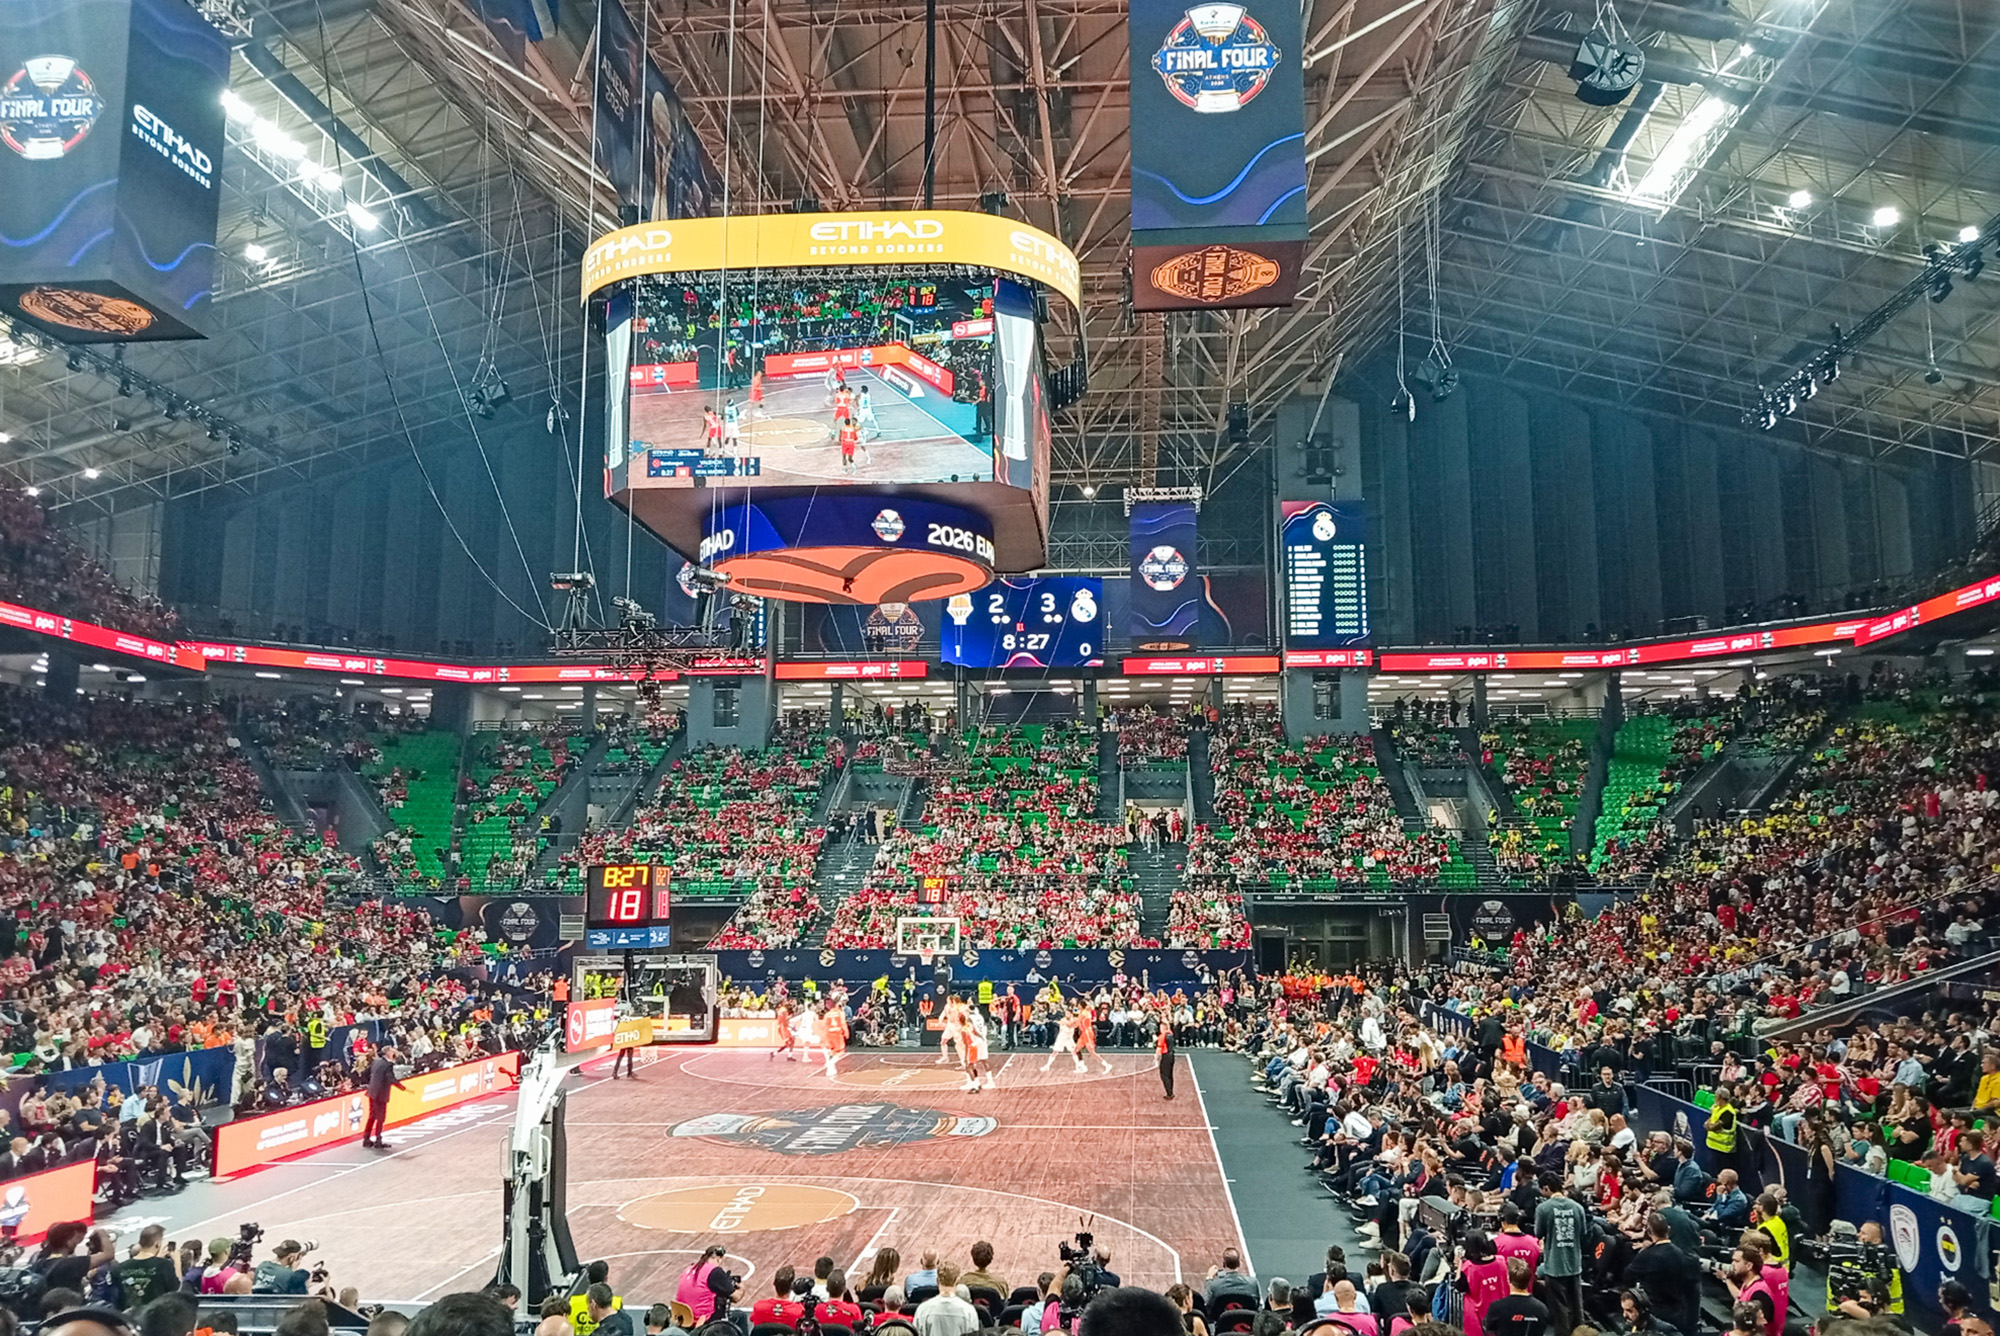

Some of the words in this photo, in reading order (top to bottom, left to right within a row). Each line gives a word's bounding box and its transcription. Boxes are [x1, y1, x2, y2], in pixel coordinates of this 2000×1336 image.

[1221, 47, 1268, 68] FOUR
[51, 98, 93, 117] FOUR
[133, 104, 212, 174] ETIHAD
[132, 123, 169, 158] BEYOND
[172, 154, 211, 189] BORDERS
[810, 219, 944, 241] ETIHAD
[586, 230, 672, 272] ETIHAD
[810, 245, 869, 255] BEYOND
[876, 243, 944, 254] BORDERS
[927, 523, 974, 552] 2026
[988, 594, 1004, 613] 2
[1041, 592, 1055, 612] 3
[895, 625, 918, 635] FOUR
[955, 645, 961, 657] 1
[1079, 643, 1092, 656] 0
[1002, 633, 1050, 650] 8:27
[603, 866, 648, 888] 8:27
[609, 890, 642, 920] 18
[926, 889, 940, 902] 18
[709, 1186, 766, 1230] ETIHAD
